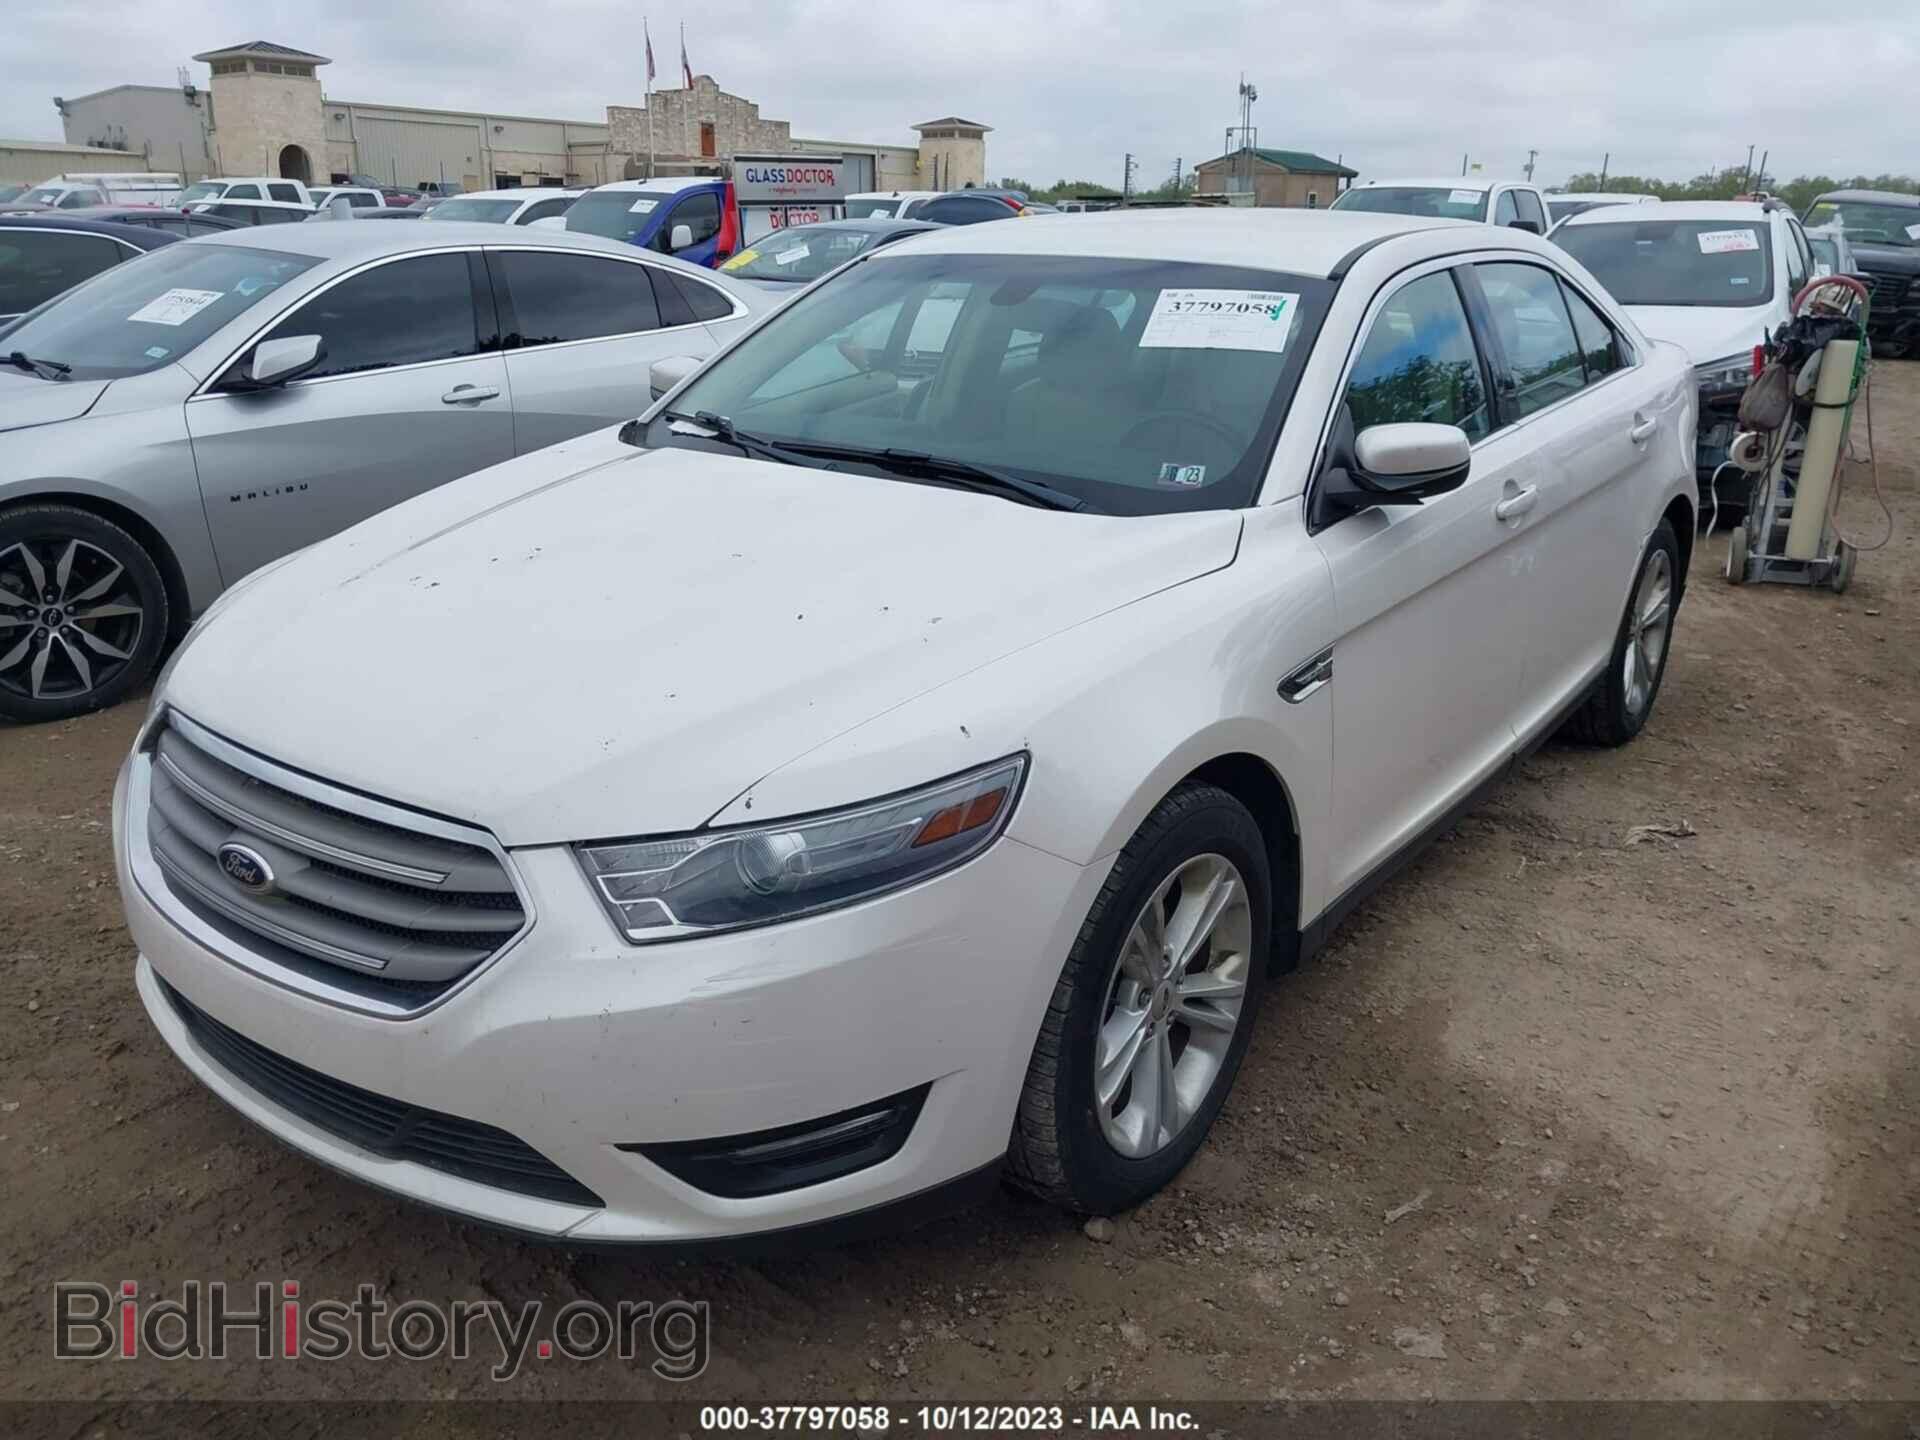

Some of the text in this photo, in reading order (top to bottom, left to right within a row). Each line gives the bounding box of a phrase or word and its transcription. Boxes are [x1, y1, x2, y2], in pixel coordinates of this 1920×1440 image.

[1168, 300, 1277, 314] 37797058
[230, 483, 308, 502] MALIBU
[226, 852, 256, 882] Ford
